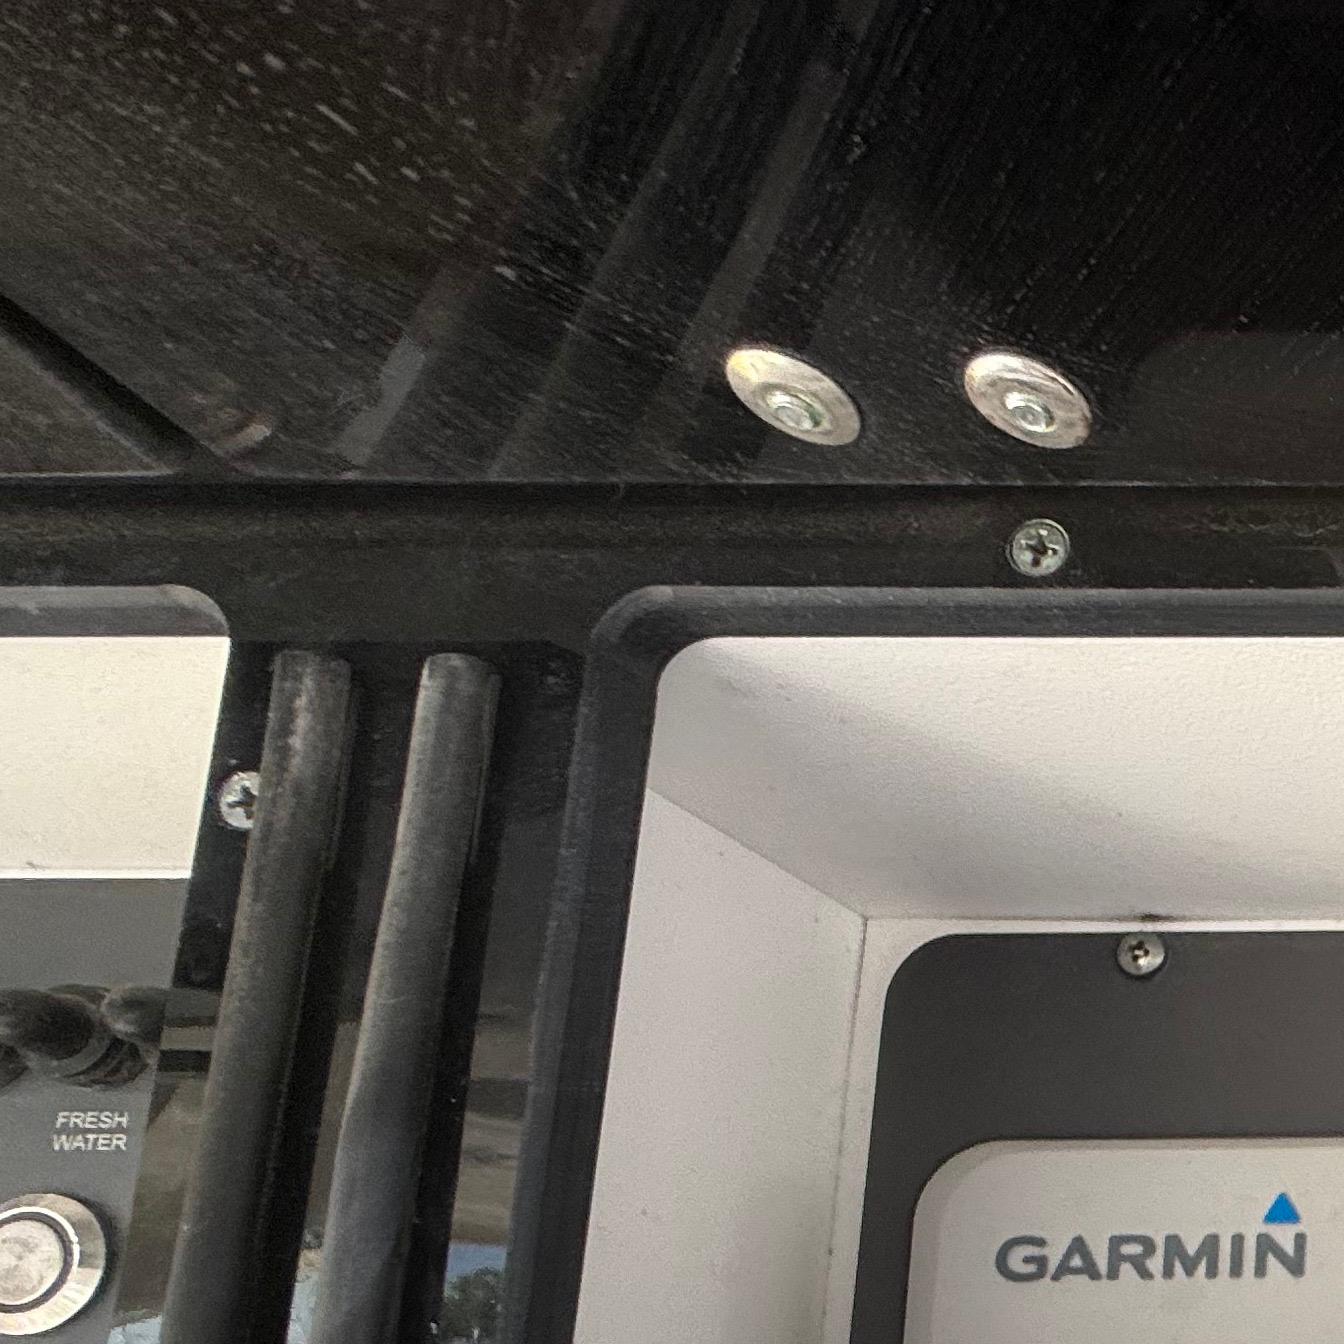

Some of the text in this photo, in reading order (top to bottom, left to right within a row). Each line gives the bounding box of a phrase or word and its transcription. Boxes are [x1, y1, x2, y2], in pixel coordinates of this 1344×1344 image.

[55, 1111, 128, 1129] FRESH
[52, 1133, 127, 1151] WATER
[995, 1232, 1307, 1282] GARMIN
